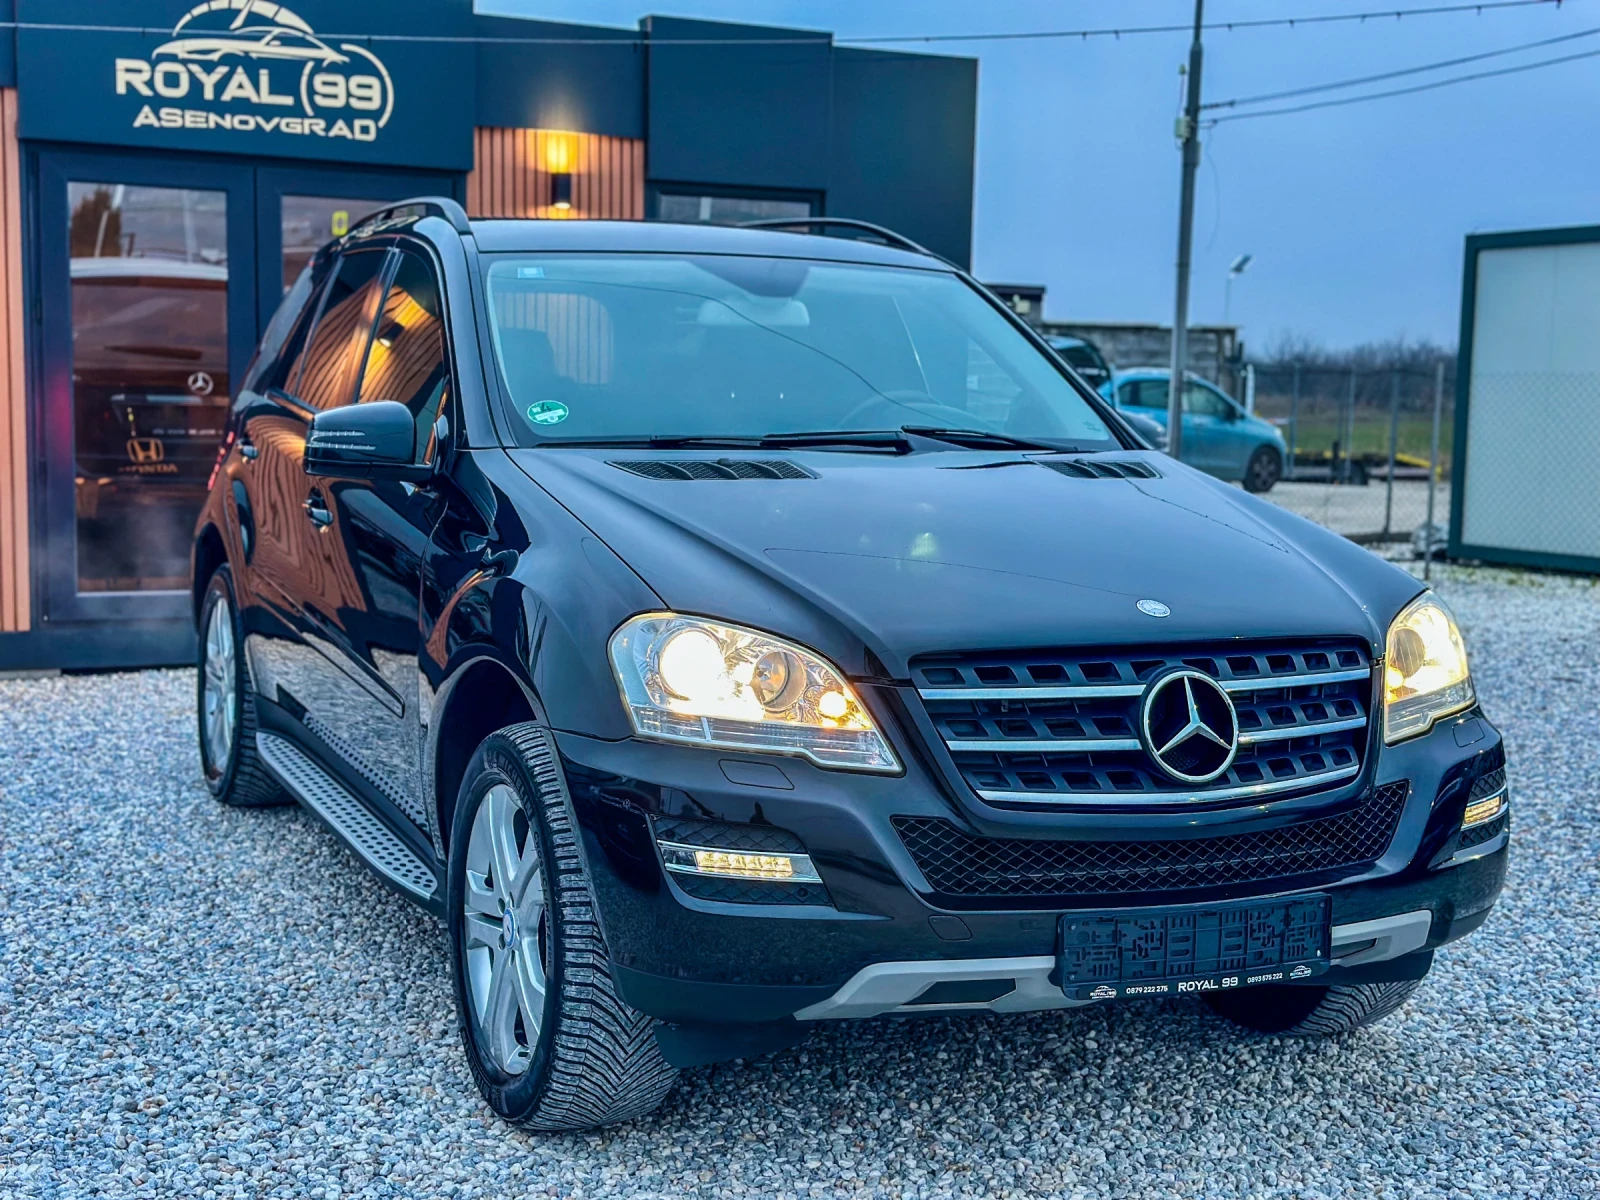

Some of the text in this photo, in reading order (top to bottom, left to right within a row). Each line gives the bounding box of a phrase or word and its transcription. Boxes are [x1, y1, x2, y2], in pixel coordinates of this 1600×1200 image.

[115, 58, 294, 106] ROYAL
[132, 104, 377, 142] ASENOVGRAD
[1178, 977, 1238, 992] ROYAL 99
